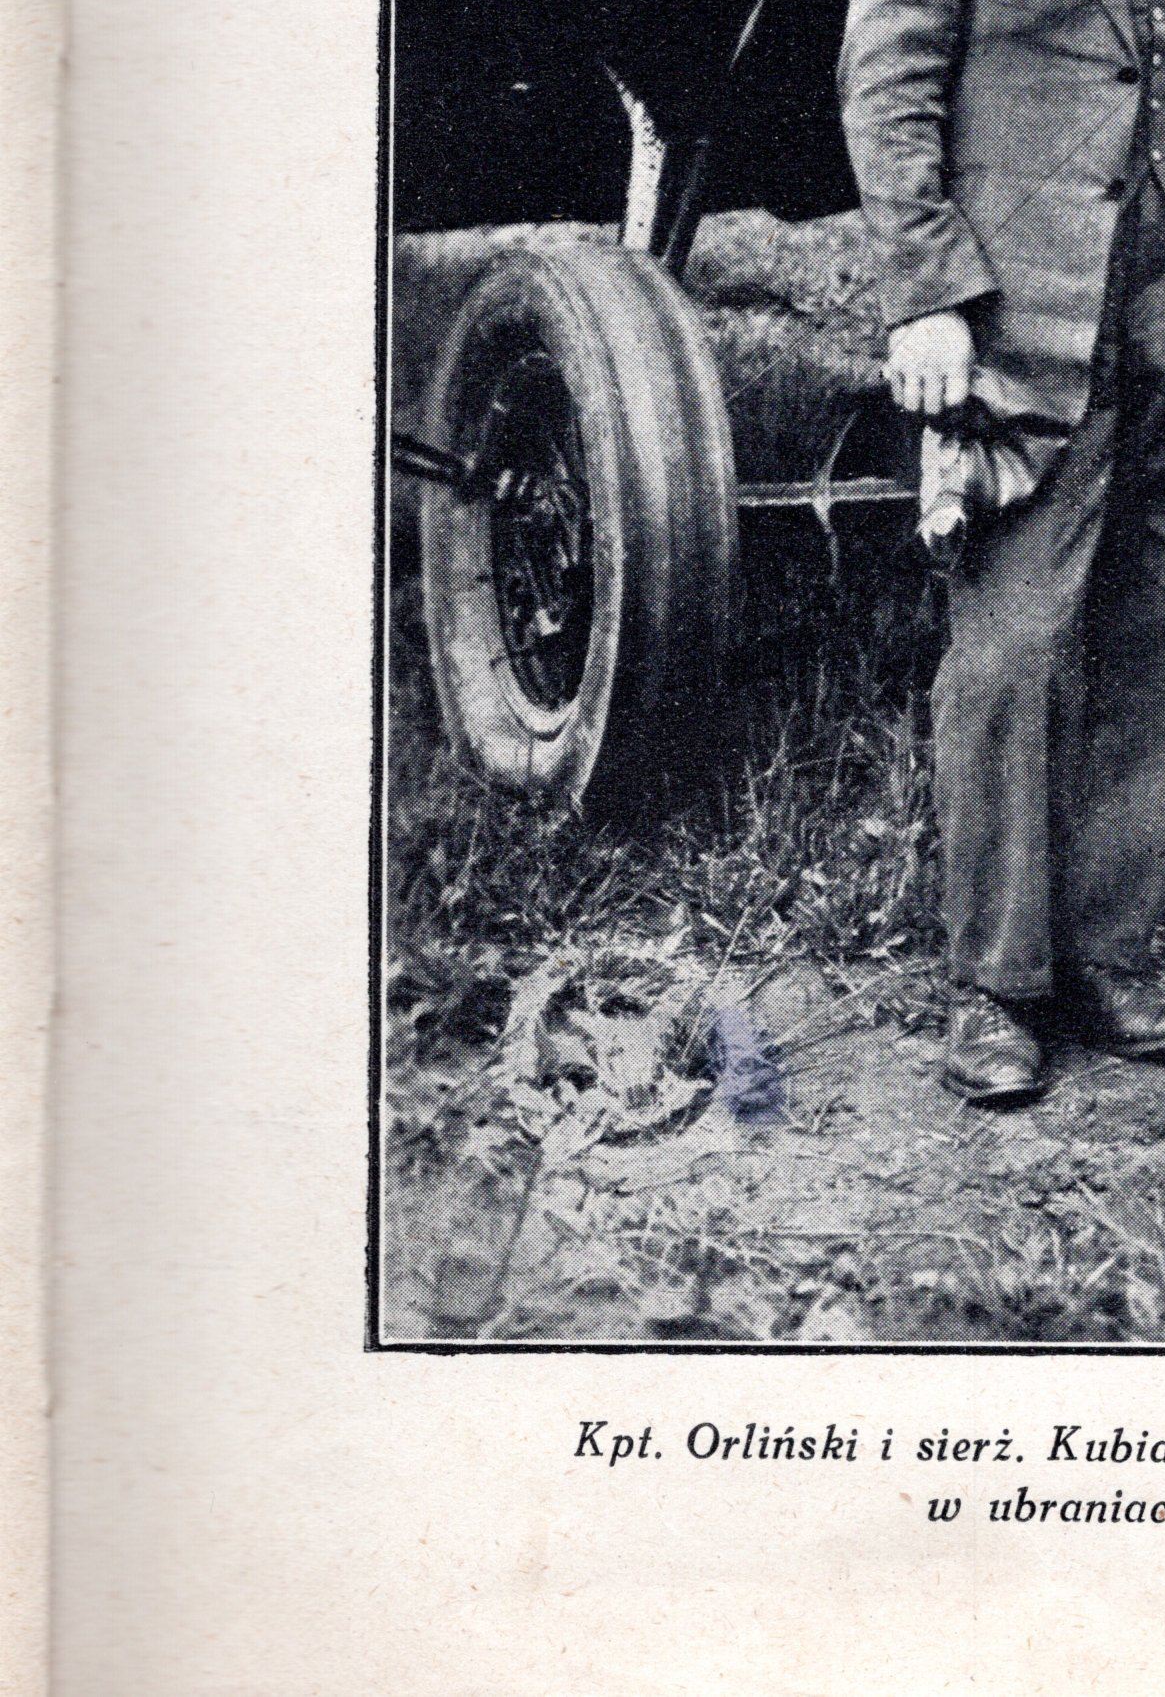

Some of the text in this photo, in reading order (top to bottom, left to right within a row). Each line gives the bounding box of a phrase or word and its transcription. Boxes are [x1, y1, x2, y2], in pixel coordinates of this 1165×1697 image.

[573, 1420, 662, 1468] Kpt.
[686, 1422, 858, 1462] Orliński
[881, 1428, 894, 1461] i
[916, 1428, 1024, 1463] sierż.
[927, 1497, 962, 1523] w
